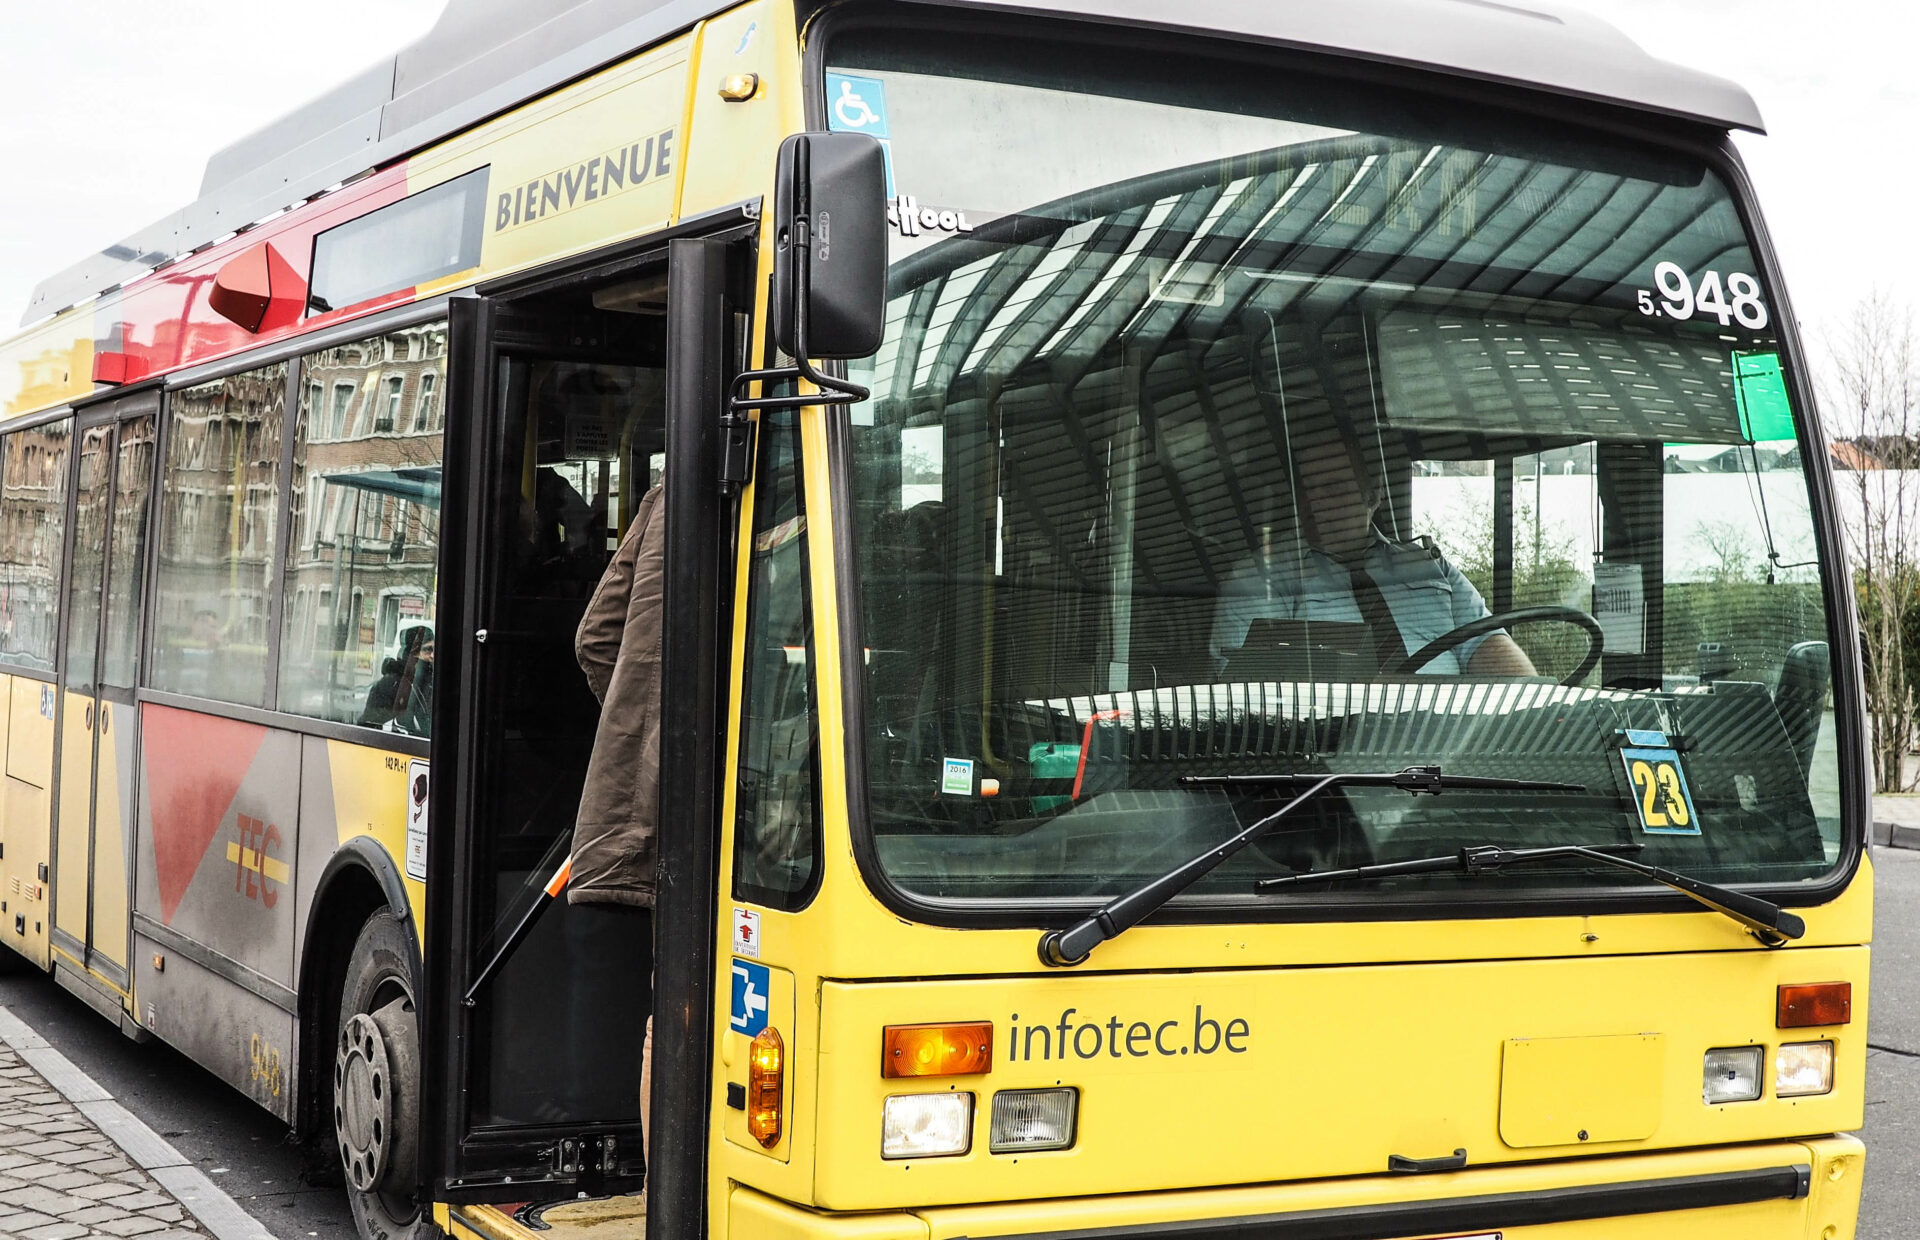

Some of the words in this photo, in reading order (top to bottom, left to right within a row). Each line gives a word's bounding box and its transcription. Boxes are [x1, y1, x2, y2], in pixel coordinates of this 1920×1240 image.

[495, 129, 673, 232] BIENVENUE
[1637, 261, 1768, 330] 5.948
[950, 766, 967, 774] 2016
[1632, 761, 1689, 826] 23
[236, 812, 281, 909] TEC
[250, 1032, 280, 1097] 948
[1009, 1005, 1250, 1062] infotec.be
